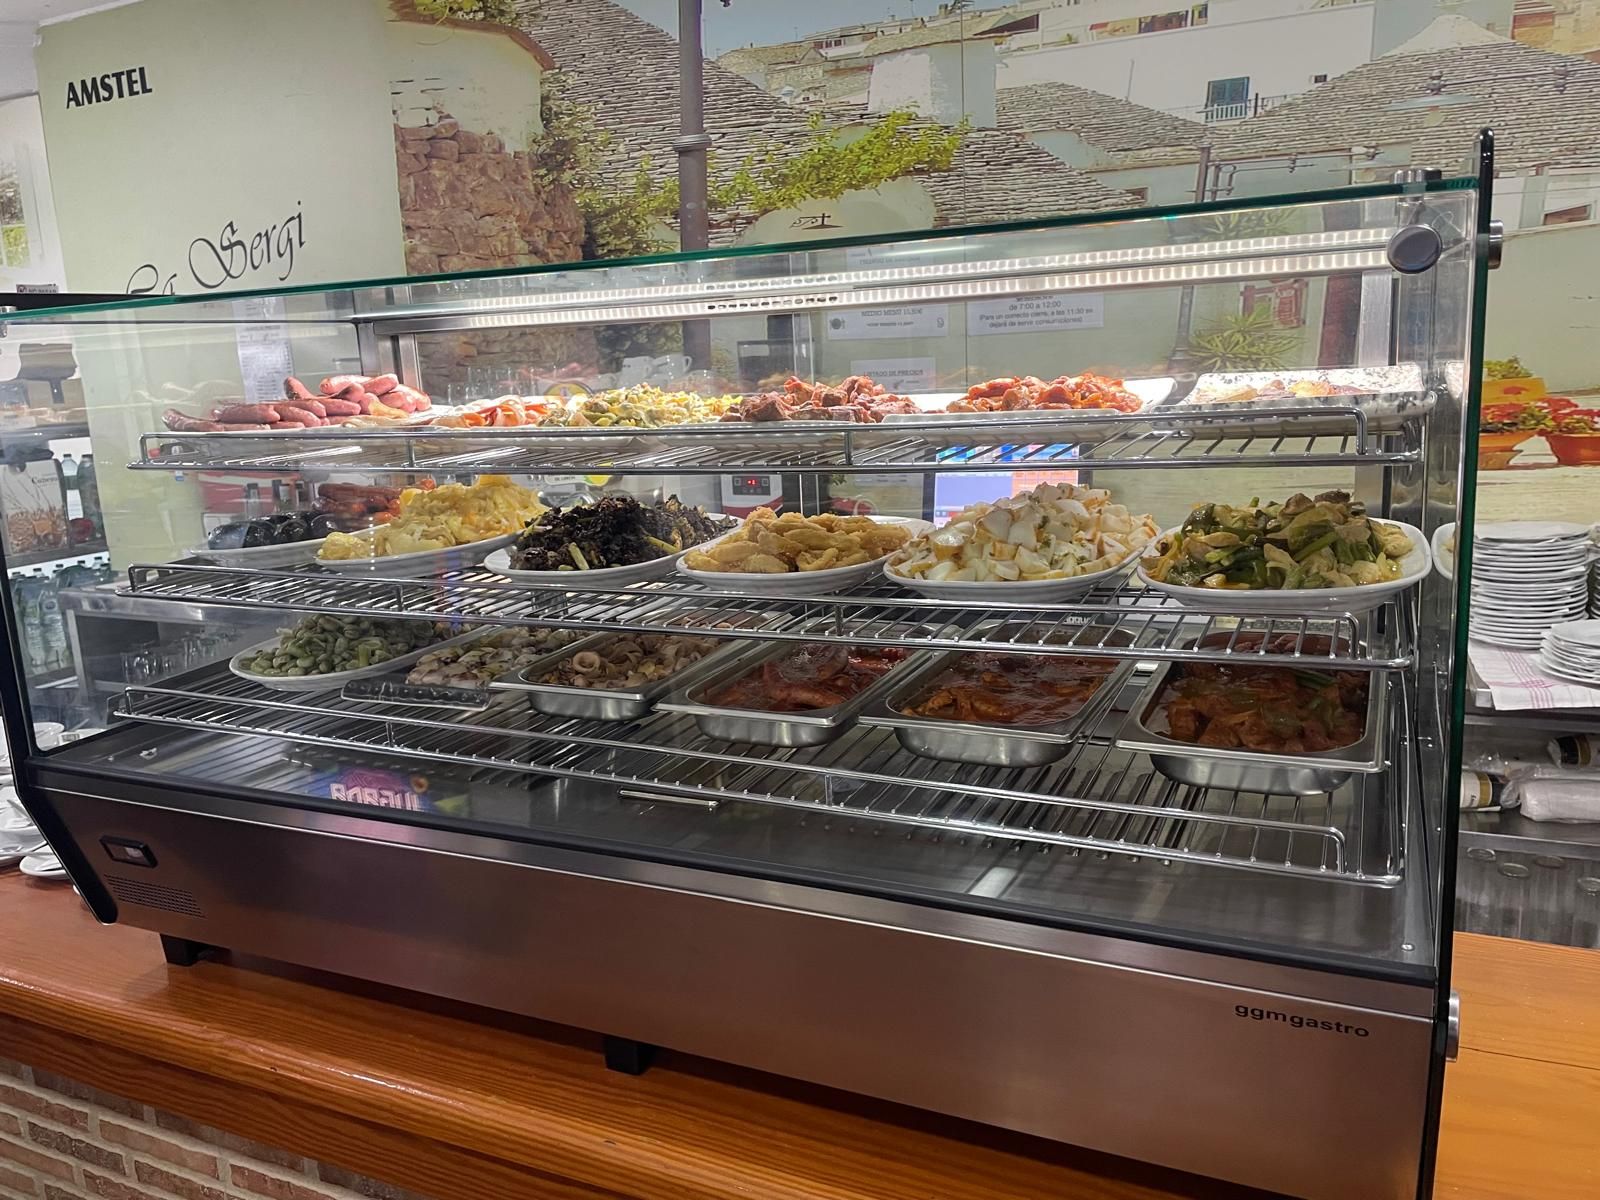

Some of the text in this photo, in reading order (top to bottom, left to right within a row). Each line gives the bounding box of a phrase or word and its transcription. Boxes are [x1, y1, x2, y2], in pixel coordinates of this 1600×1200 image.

[66, 66, 153, 110] AMSTEL
[188, 200, 306, 289] Sergi
[1234, 1004, 1370, 1038] ggmgastro
